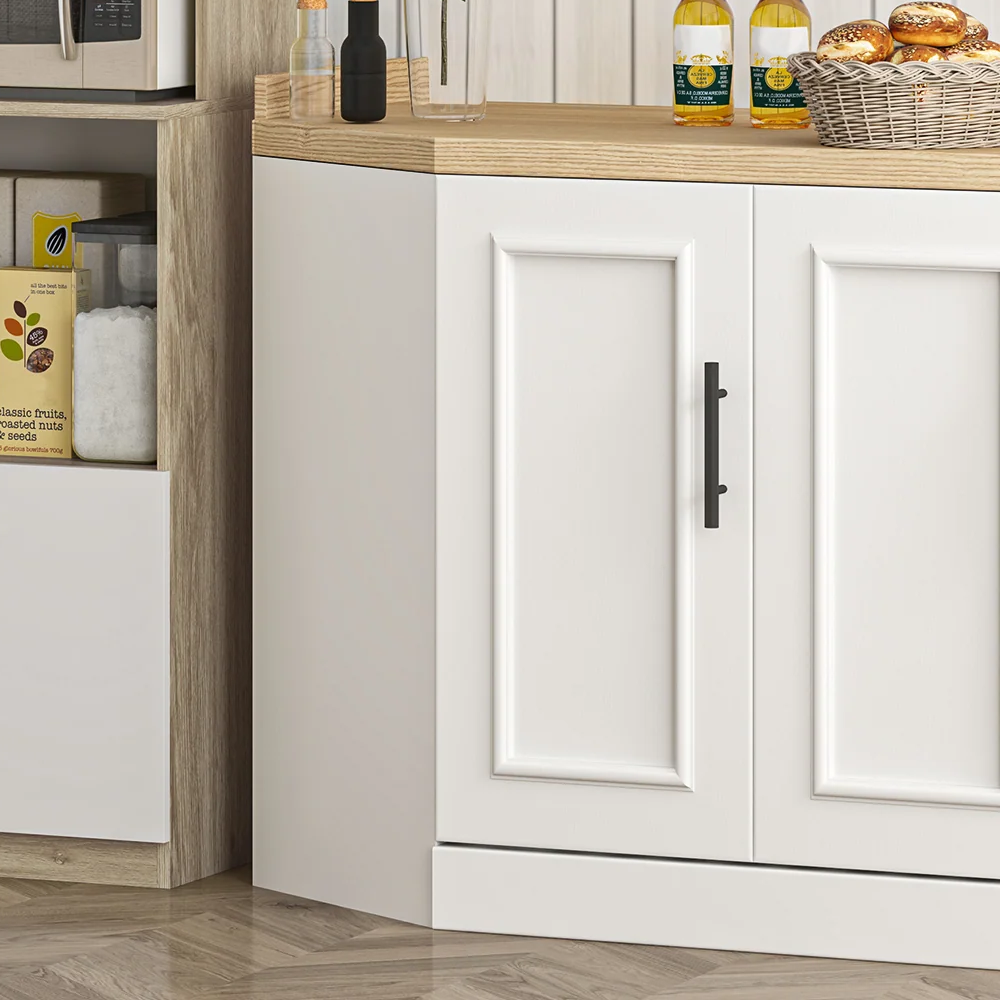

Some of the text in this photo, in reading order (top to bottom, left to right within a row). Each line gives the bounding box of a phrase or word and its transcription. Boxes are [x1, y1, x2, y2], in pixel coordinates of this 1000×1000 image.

[34, 408, 67, 421] fruits,
[38, 421, 64, 431] nuts
[7, 431, 37, 441] seeds
